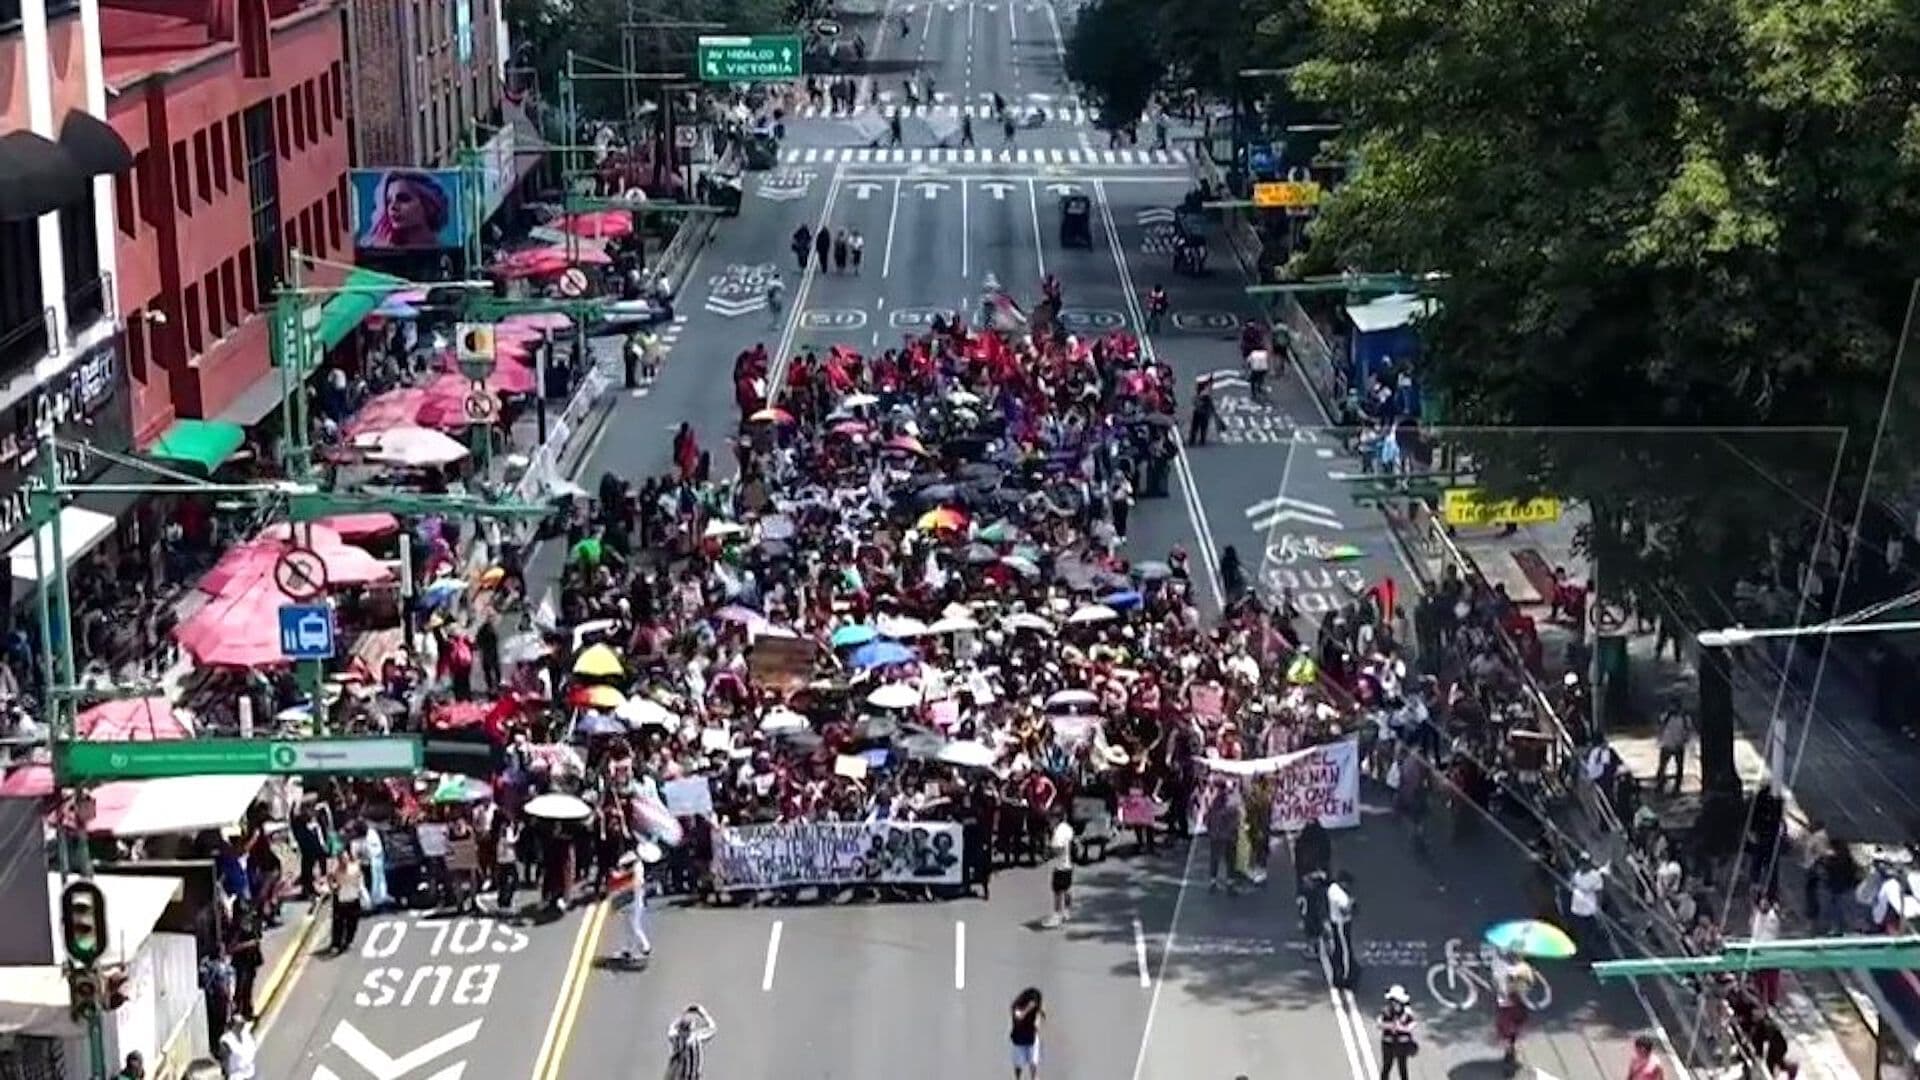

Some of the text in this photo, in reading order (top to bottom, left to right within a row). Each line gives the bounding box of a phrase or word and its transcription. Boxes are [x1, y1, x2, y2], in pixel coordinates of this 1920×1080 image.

[708, 48, 775, 61] AV HIDALGO
[725, 62, 793, 75] VICTORIA
[362, 918, 530, 958] SOLO
[355, 963, 501, 1006] BUS
